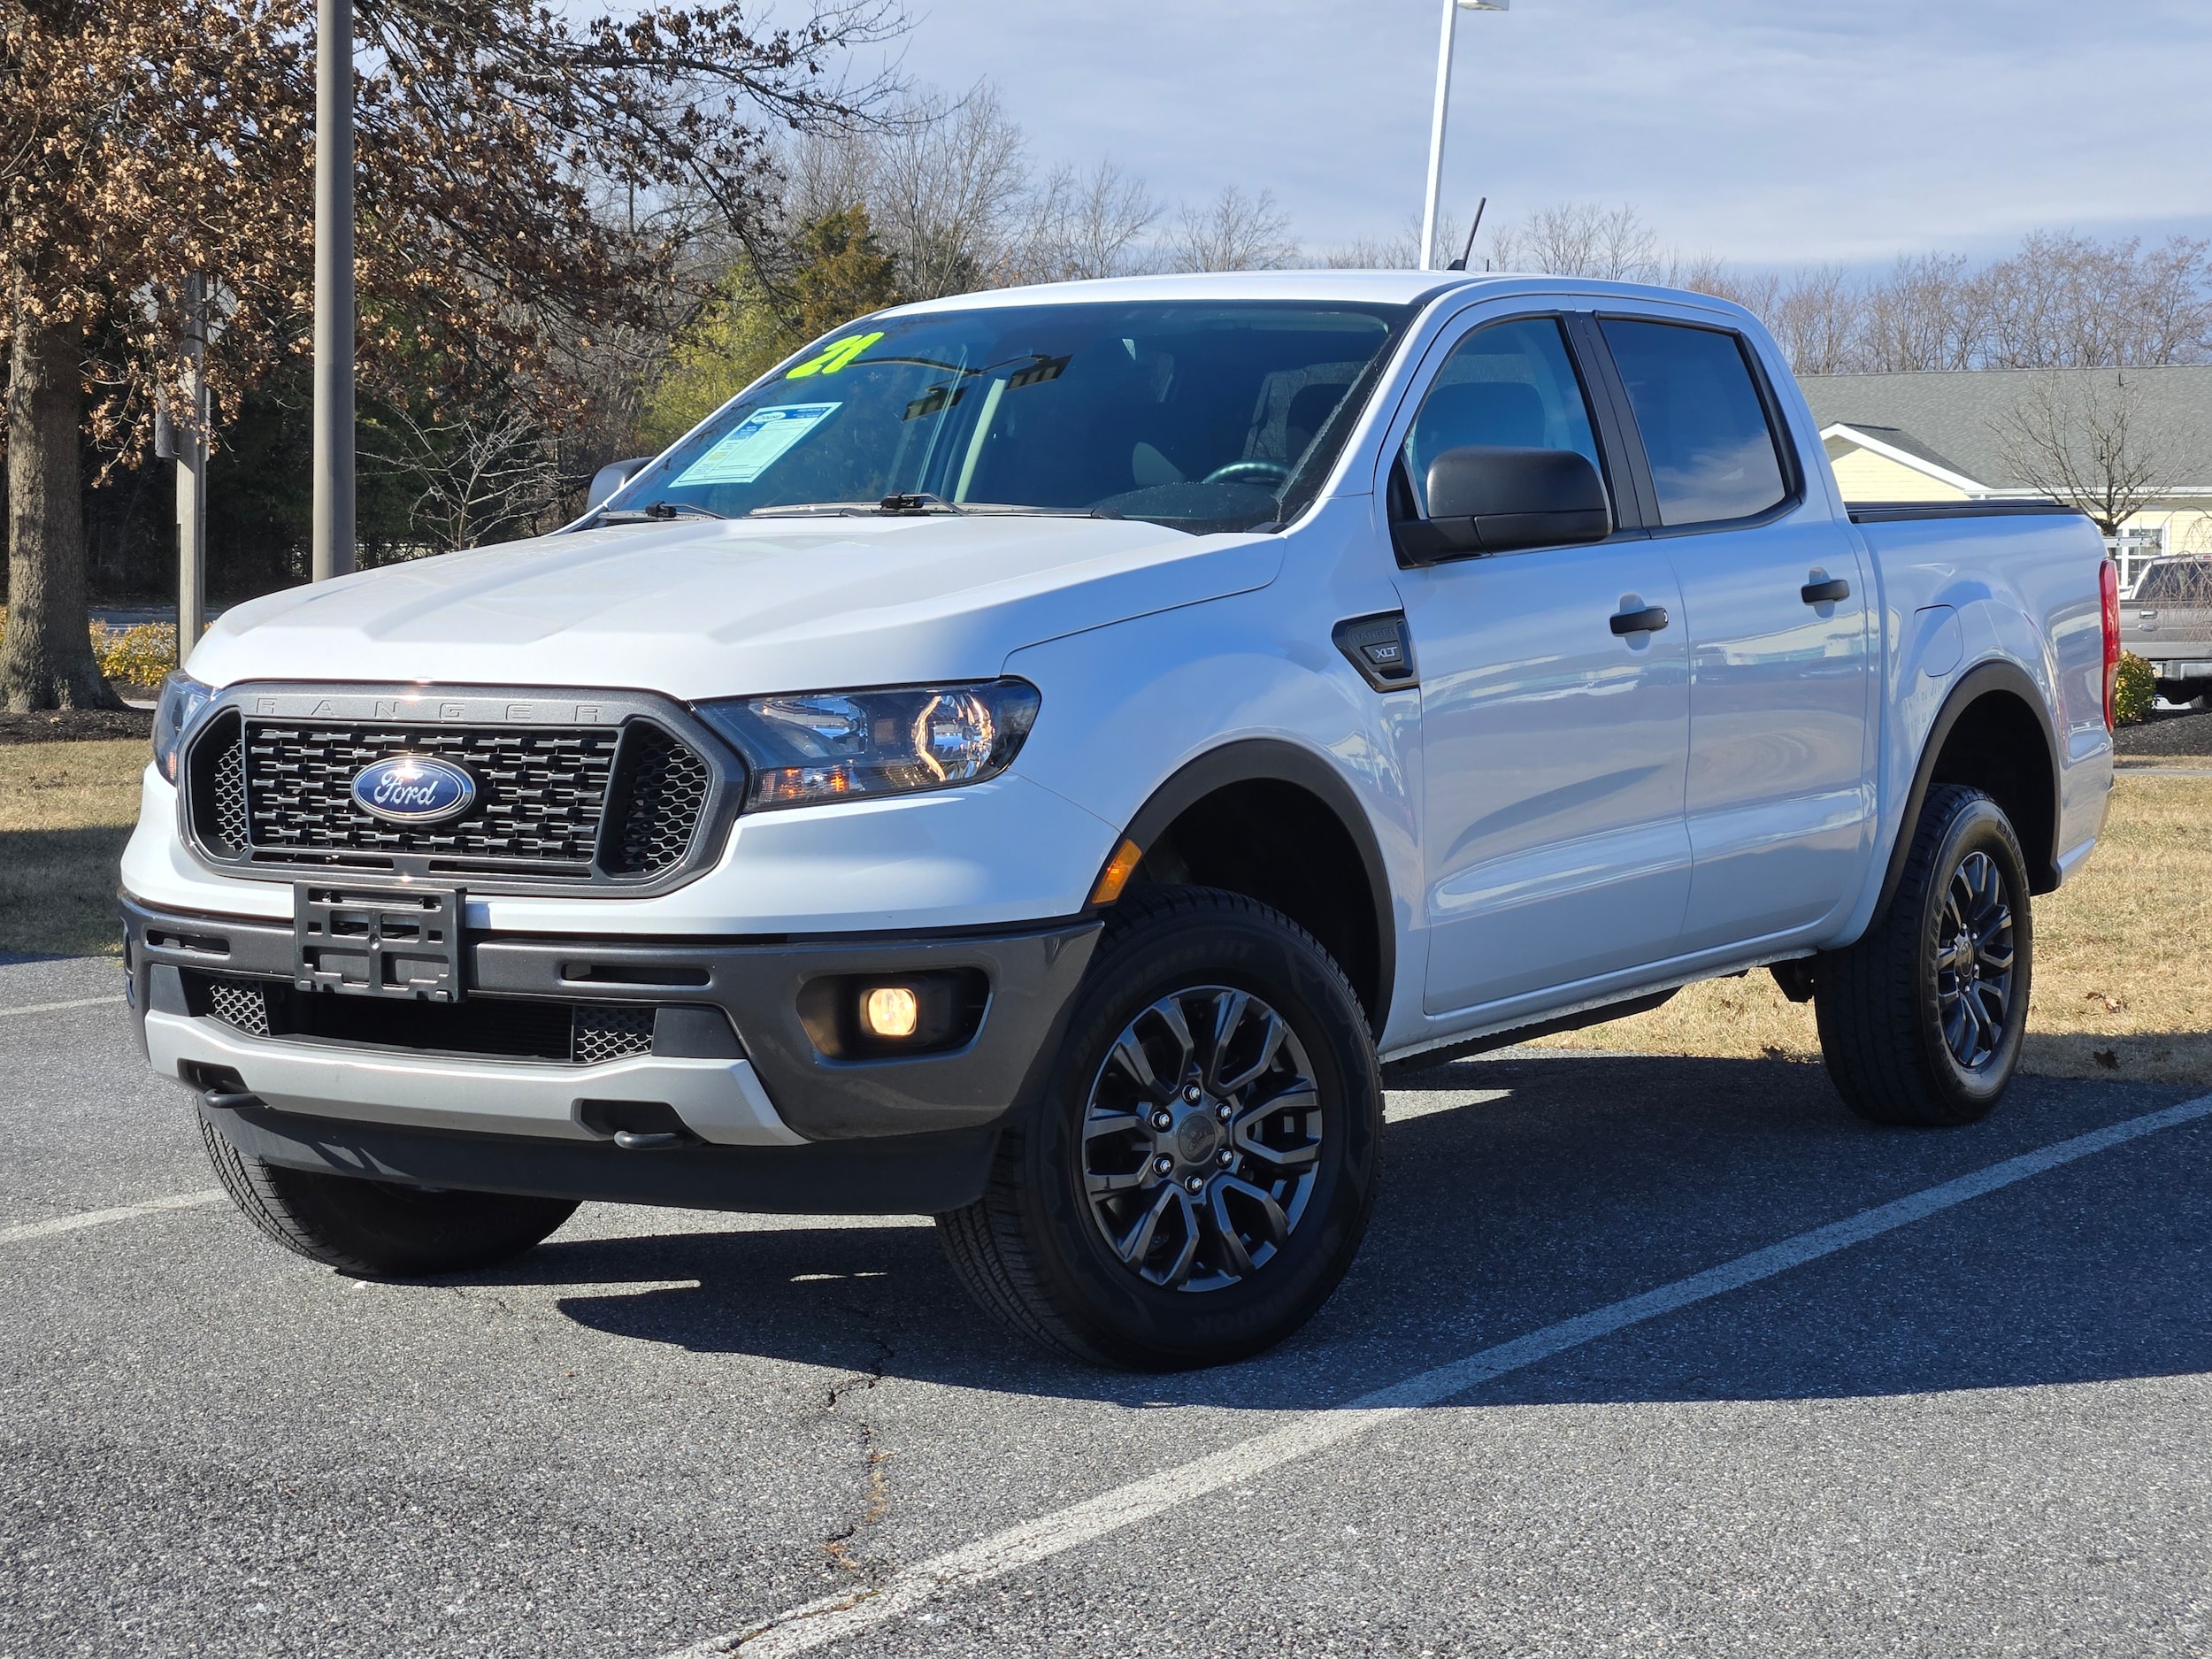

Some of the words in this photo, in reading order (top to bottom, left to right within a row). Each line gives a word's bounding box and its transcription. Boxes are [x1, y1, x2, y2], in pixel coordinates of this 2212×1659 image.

[1351, 626, 1396, 641] RANGER
[1375, 646, 1397, 659] XLT
[255, 697, 603, 724] RANGER
[373, 768, 440, 806] Ford
